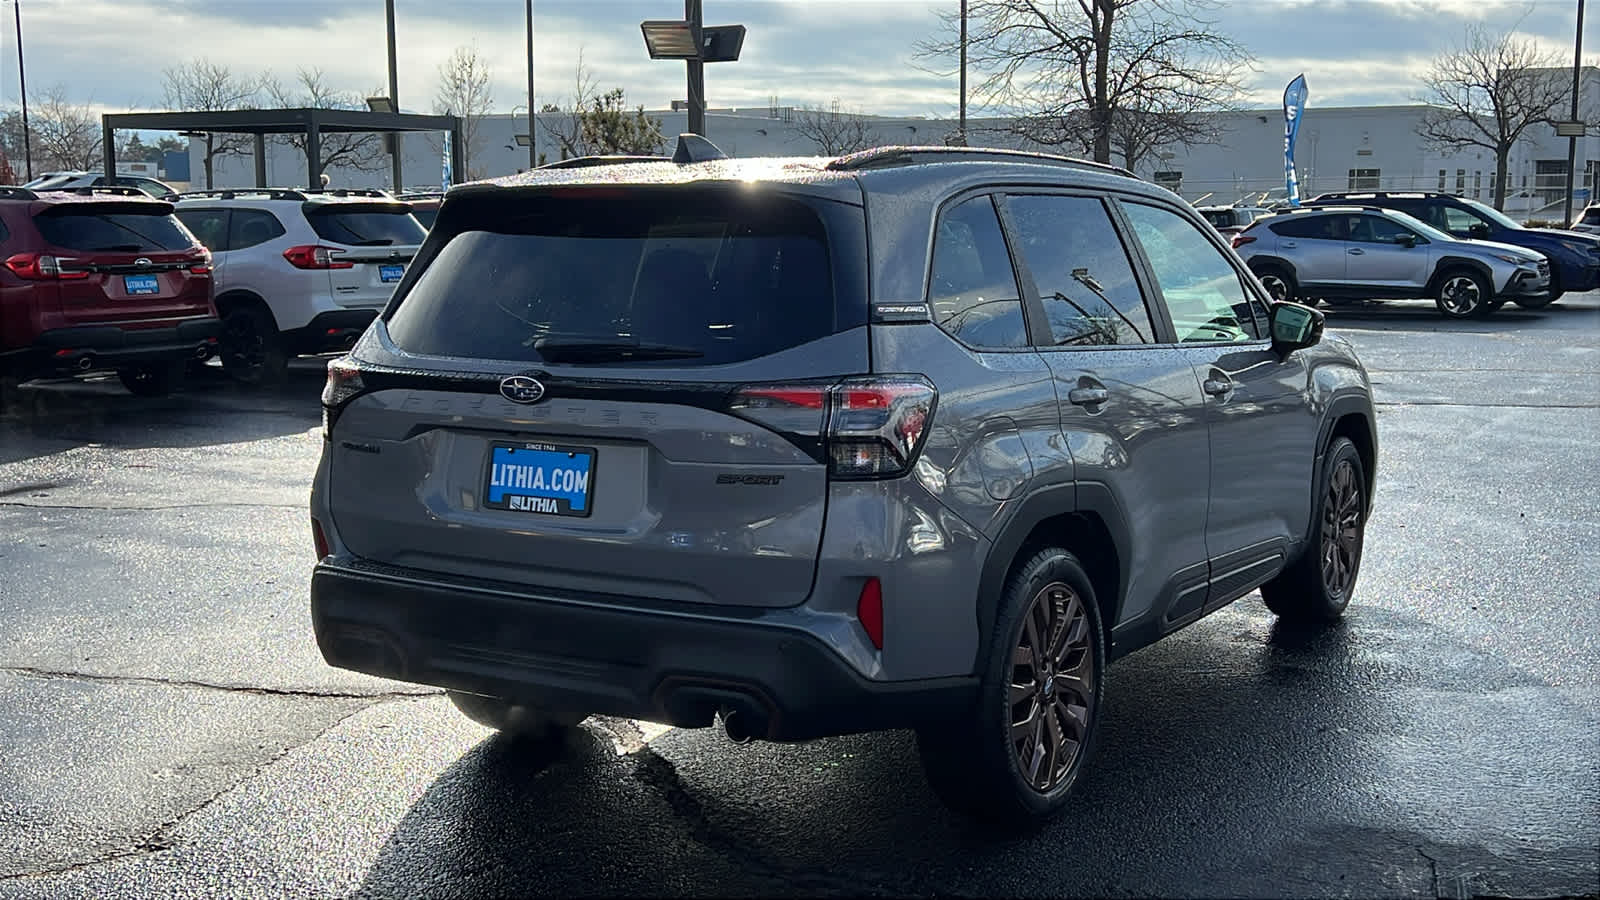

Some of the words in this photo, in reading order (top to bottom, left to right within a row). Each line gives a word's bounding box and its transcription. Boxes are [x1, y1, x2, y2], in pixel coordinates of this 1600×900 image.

[525, 443, 542, 451] SINCE
[490, 463, 589, 494] LITHIA.COM
[715, 473, 785, 486] SPORT
[520, 496, 558, 513] LITHIA
